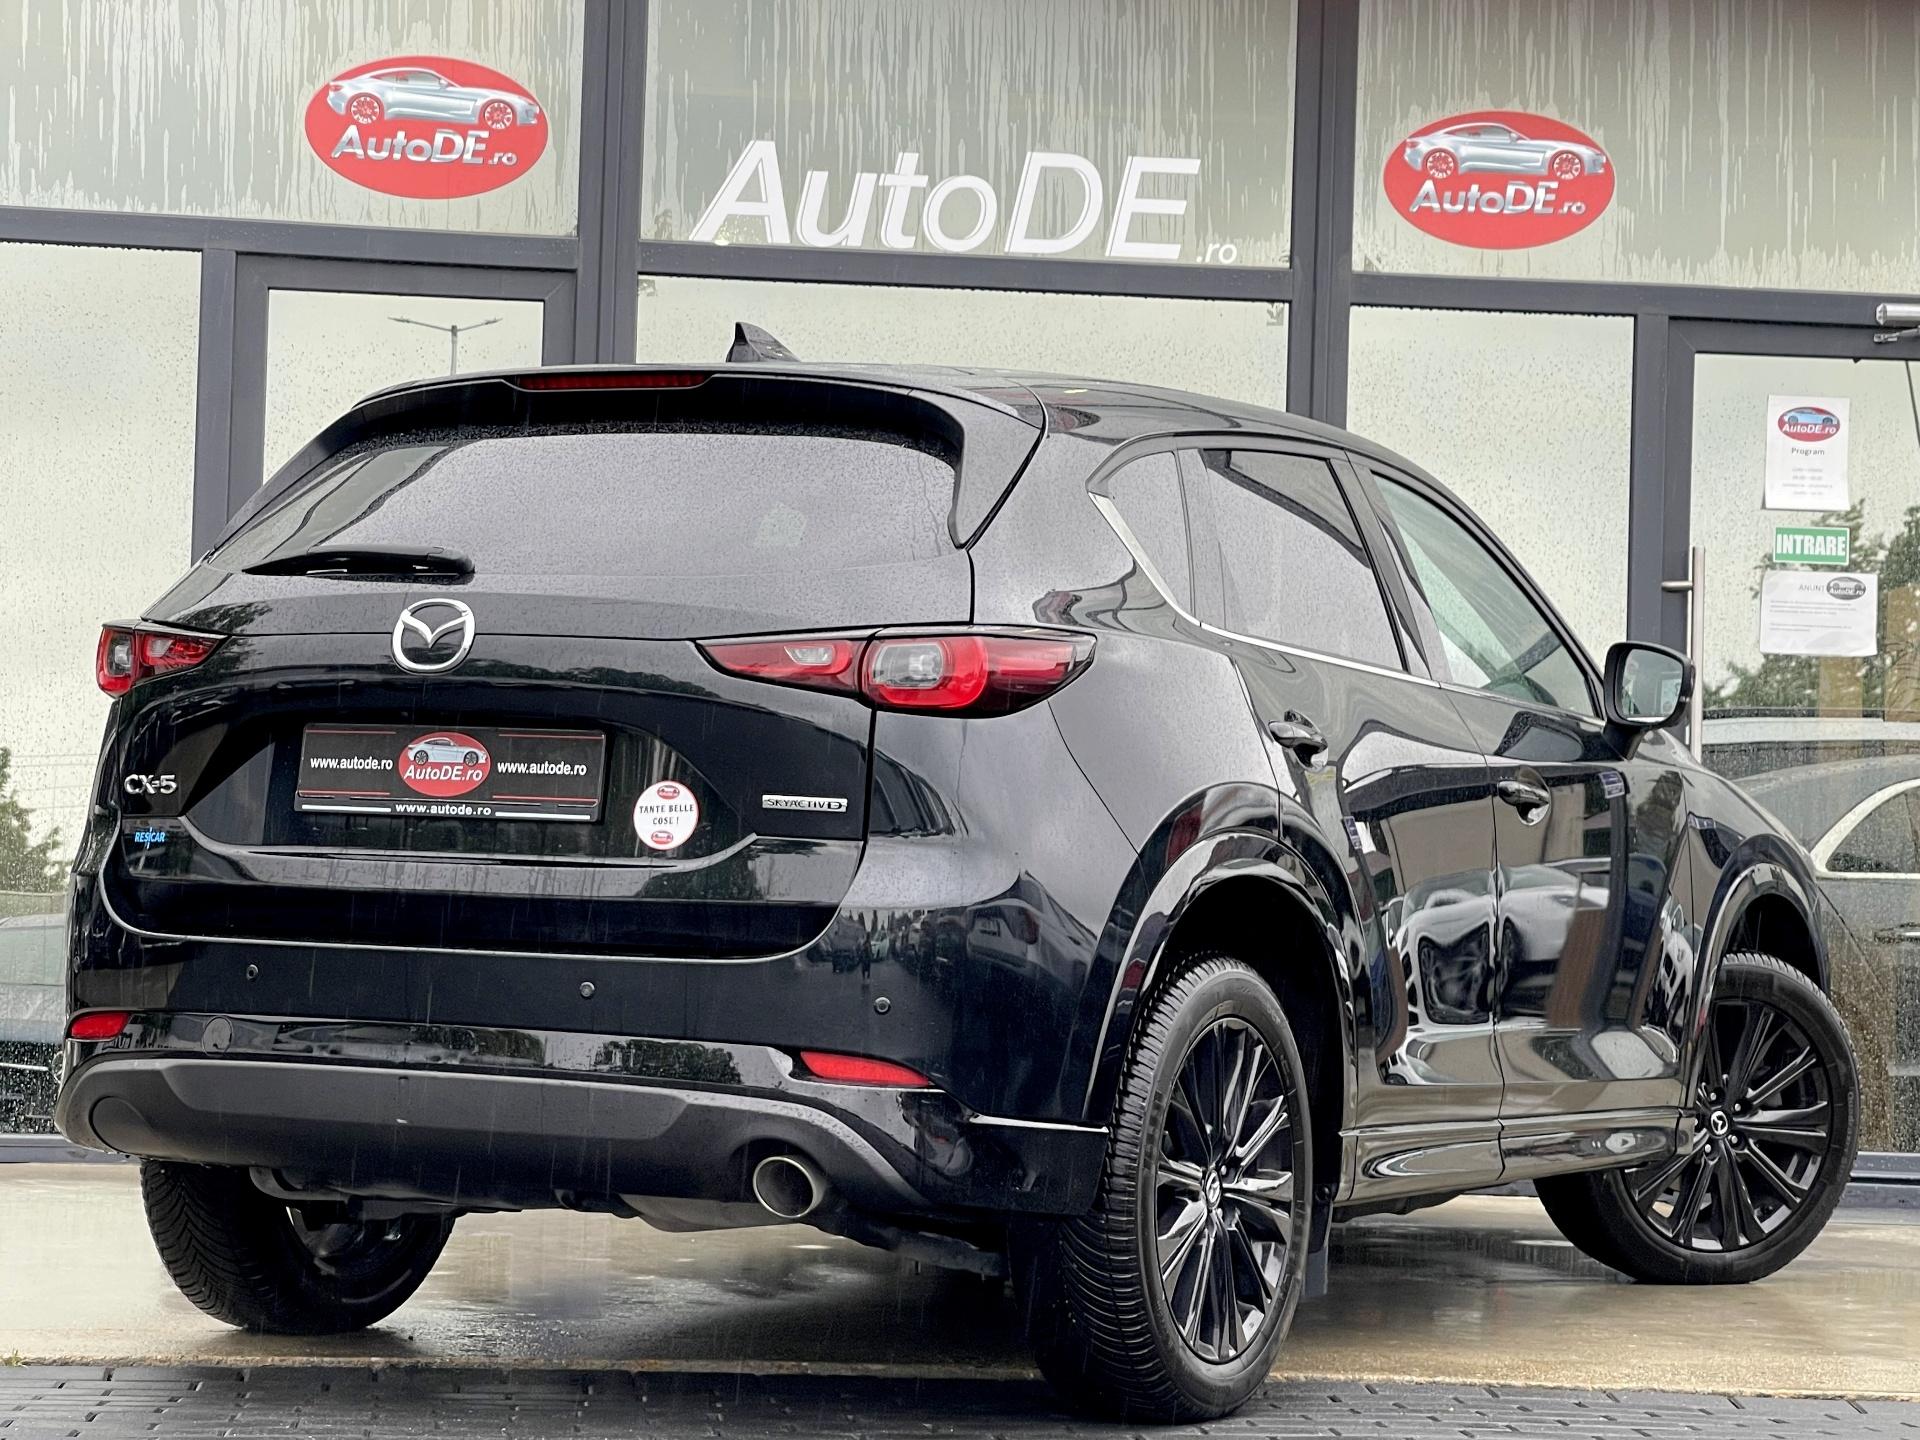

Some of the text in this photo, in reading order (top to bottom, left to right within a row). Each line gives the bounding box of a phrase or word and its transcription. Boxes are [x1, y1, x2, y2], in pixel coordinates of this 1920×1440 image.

[1782, 423, 1837, 435] AutoDE.ro
[1791, 447, 1825, 457] Program
[1776, 533, 1846, 556] INTRARE
[310, 756, 393, 771] www.autode.ro
[497, 761, 587, 776] www.autode.ro
[403, 764, 484, 782] AutoDE.ro
[124, 773, 177, 794] CX-5
[395, 803, 492, 816] www.autode.ro
[639, 803, 694, 814] TANTE BELLE
[652, 816, 674, 825] COSE
